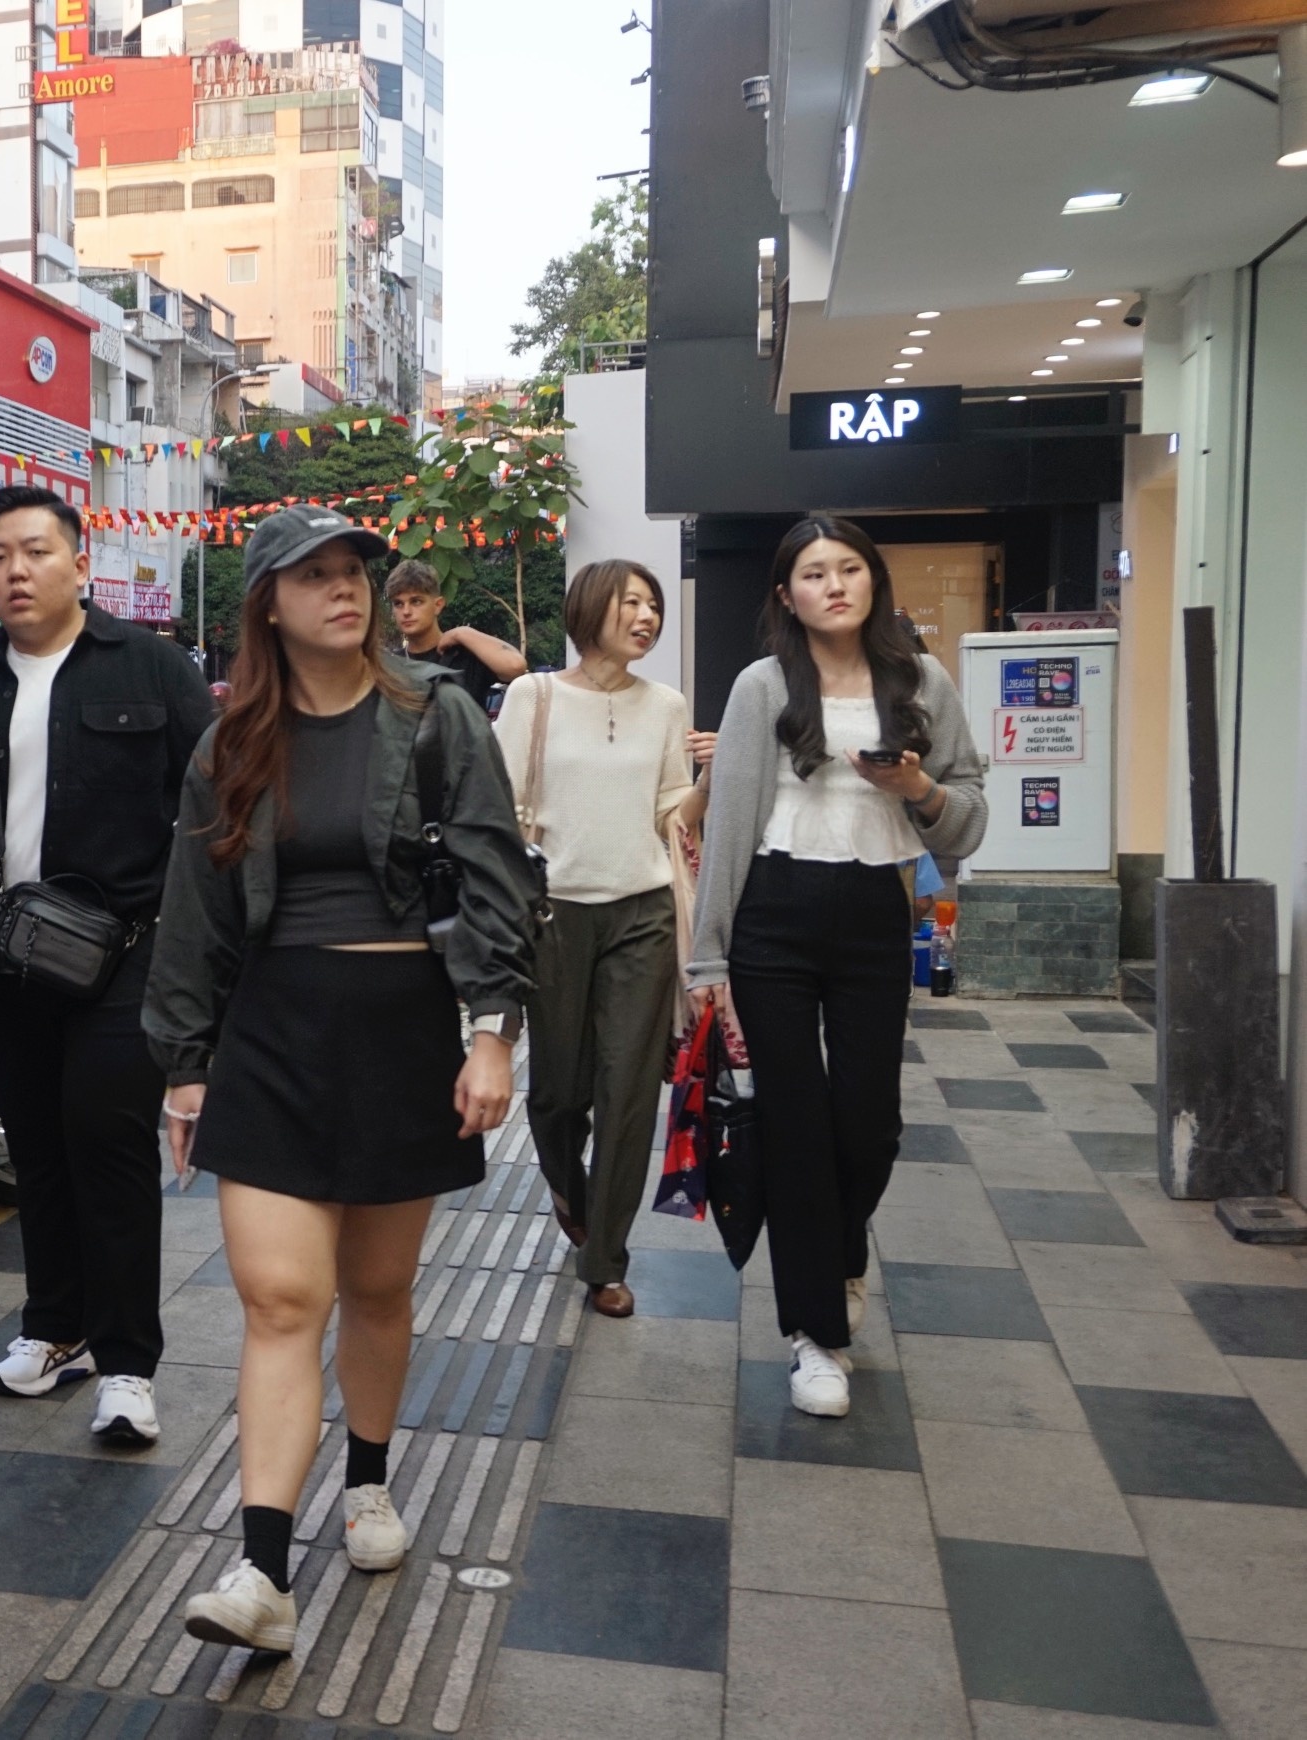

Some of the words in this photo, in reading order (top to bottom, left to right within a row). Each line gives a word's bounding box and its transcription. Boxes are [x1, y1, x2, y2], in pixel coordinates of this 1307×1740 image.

[36, 73, 114, 99] Amore
[830, 393, 920, 443] RẬP
[1038, 662, 1073, 670] TECHNO
[1038, 669, 1061, 677] RAVE
[1027, 736, 1050, 744] NGUY
